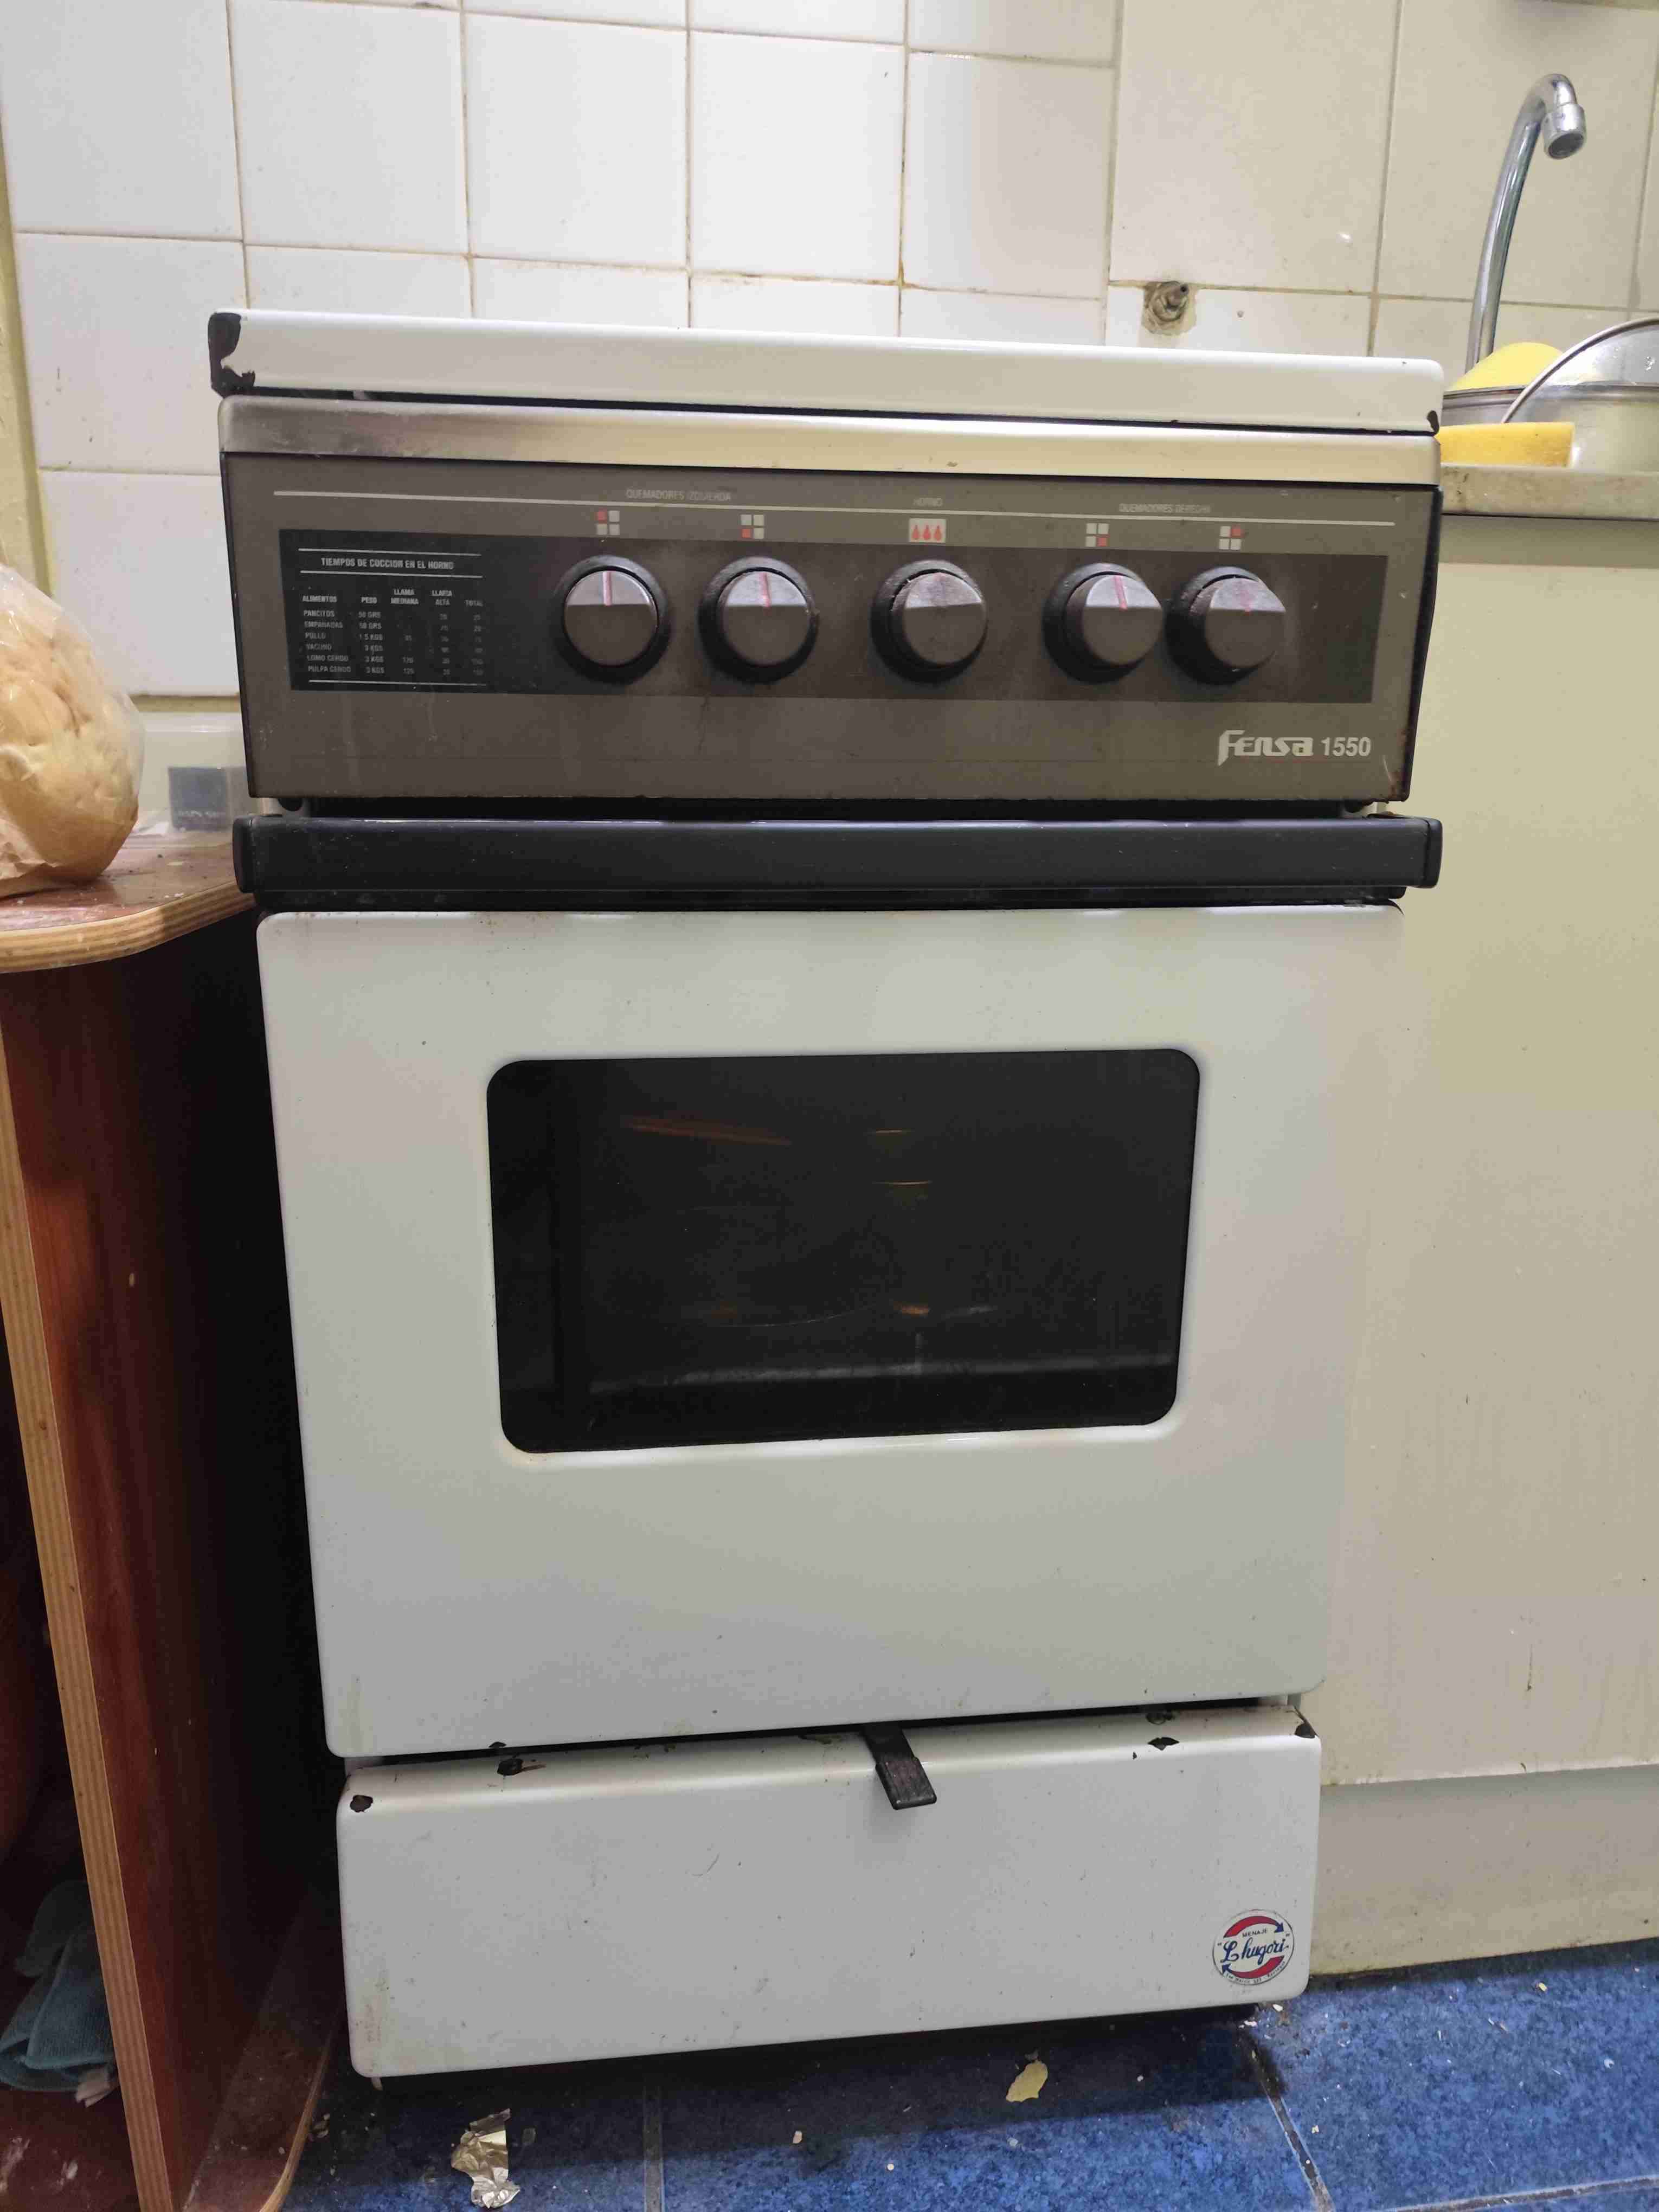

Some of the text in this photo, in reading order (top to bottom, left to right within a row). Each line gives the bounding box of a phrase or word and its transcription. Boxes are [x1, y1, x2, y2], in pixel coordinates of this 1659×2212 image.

[321, 557, 454, 569] TIEMPOS DE COCCION EN EL HORNO
[1321, 736, 1371, 757] 1550
[1242, 1927, 1267, 1938] MENAJE
